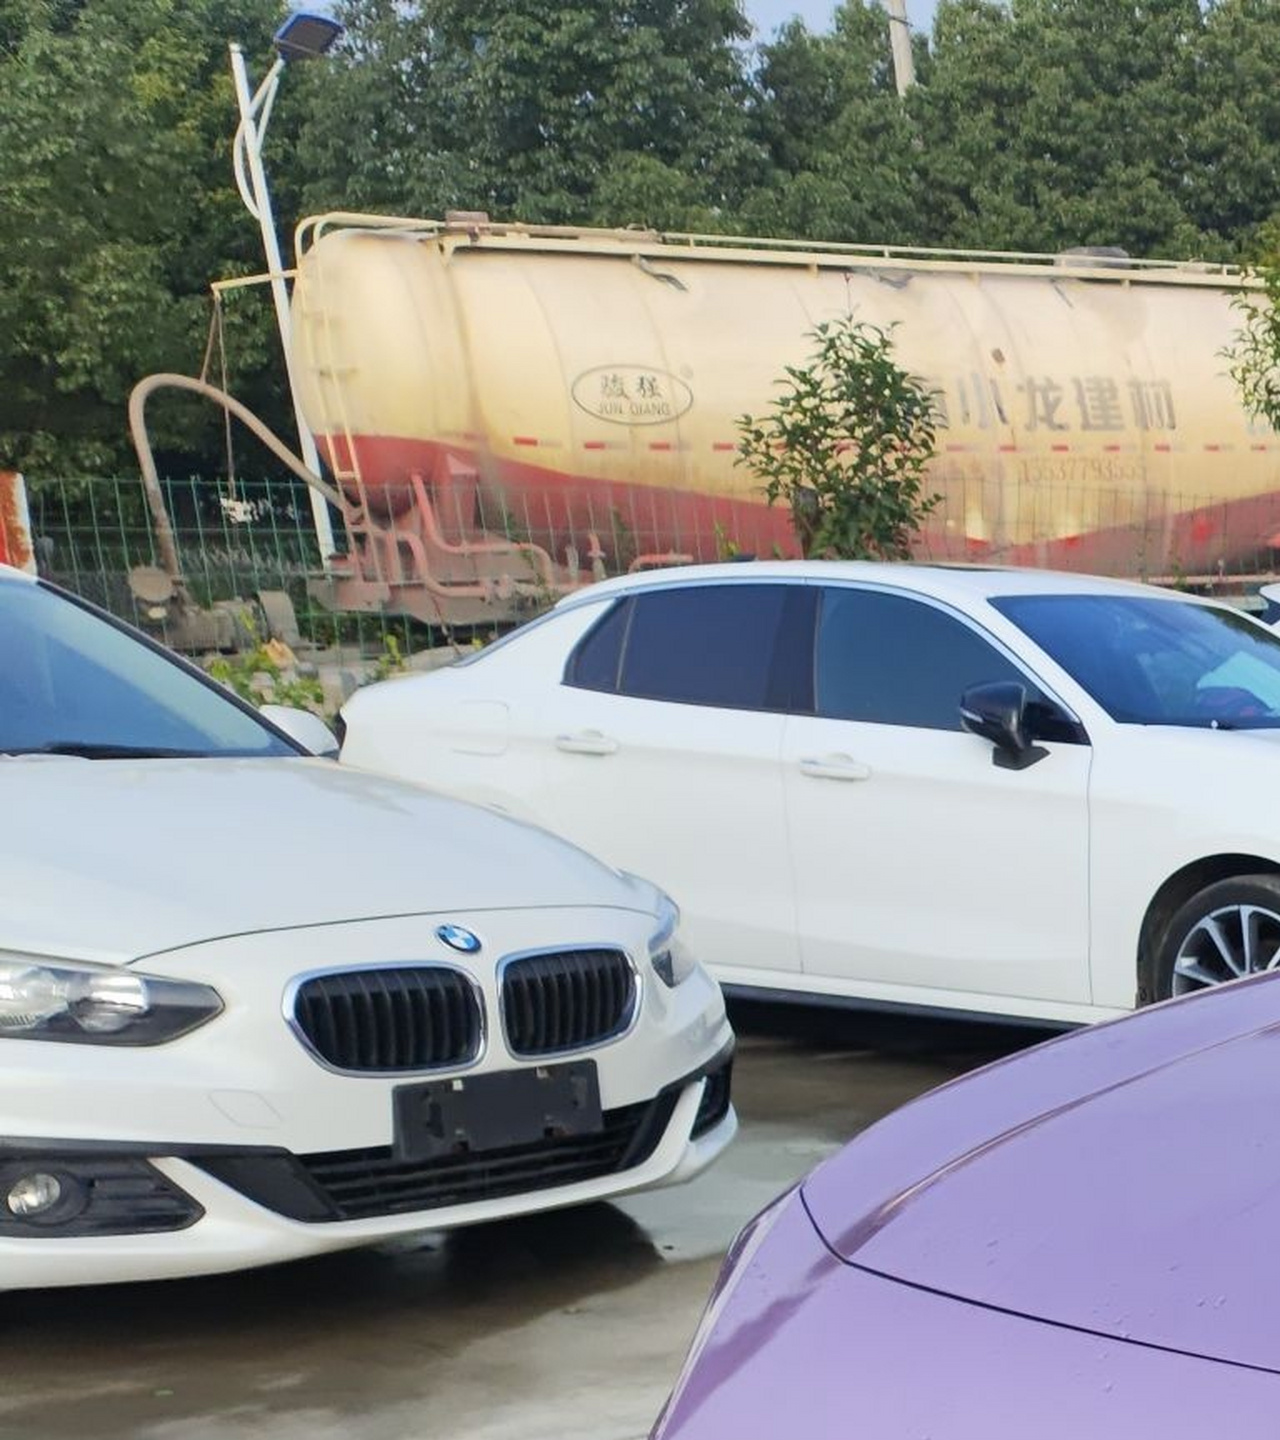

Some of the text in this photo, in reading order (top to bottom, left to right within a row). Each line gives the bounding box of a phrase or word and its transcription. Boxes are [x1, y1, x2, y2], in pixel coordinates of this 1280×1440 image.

[629, 401, 670, 416] QIANG
[932, 372, 1177, 432] 小龙建材
